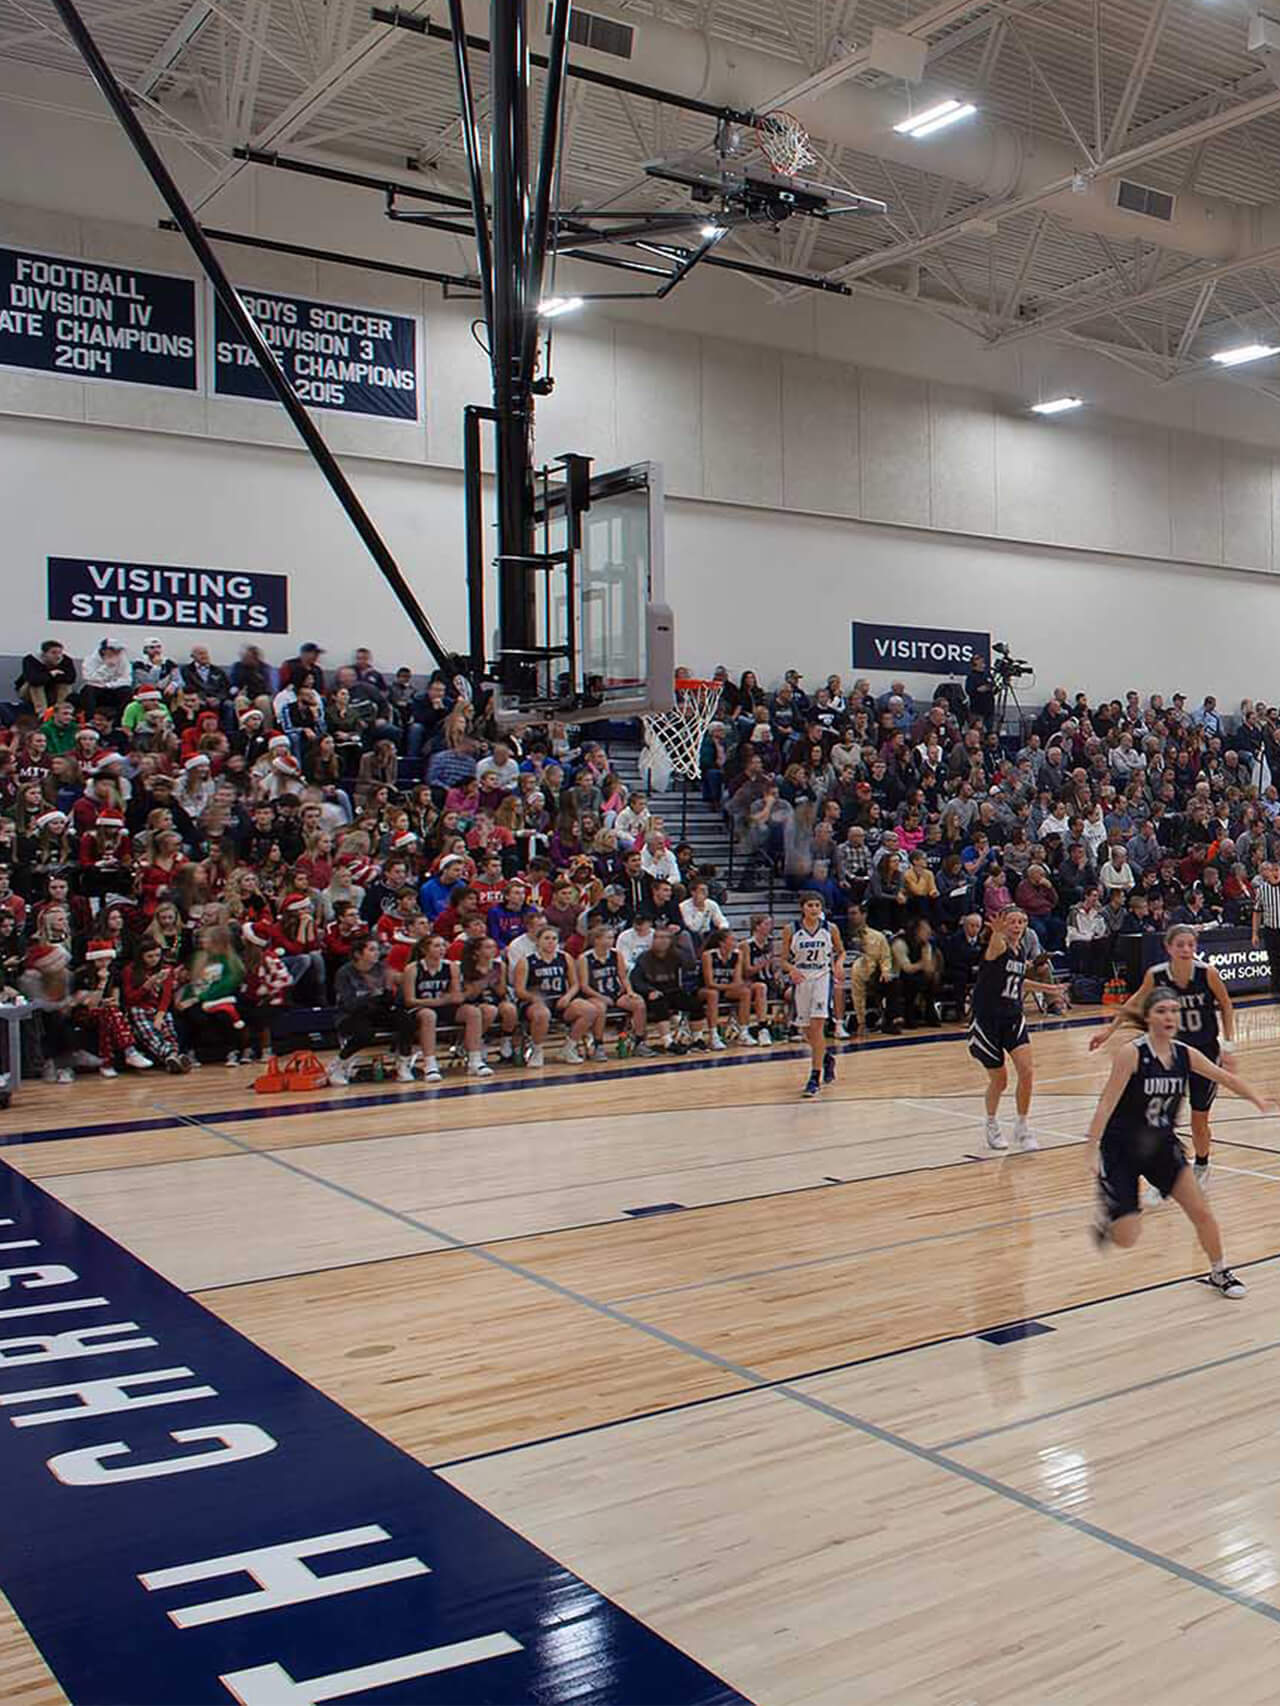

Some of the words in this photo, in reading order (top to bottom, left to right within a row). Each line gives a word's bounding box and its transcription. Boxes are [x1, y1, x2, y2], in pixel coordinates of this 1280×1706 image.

[17, 258, 145, 300] FOOTBALL
[10, 283, 113, 321] DIVISION
[129, 303, 152, 326] IV
[56, 318, 193, 358] CHAMPIONS
[309, 308, 393, 341] SOCCER
[260, 323, 349, 357] DIVISION
[359, 340, 374, 361] 3
[55, 345, 112, 373] 2014
[217, 341, 285, 369] STAE
[293, 353, 415, 391] CHAMPIONS
[295, 379, 345, 405] 2015
[87, 565, 253, 599] VISITING
[71, 593, 269, 628] STUDENTS
[873, 638, 973, 662] VISITORS
[806, 950, 819, 962] 21
[1208, 952, 1247, 966] SOUTH
[1218, 966, 1237, 980] GH
